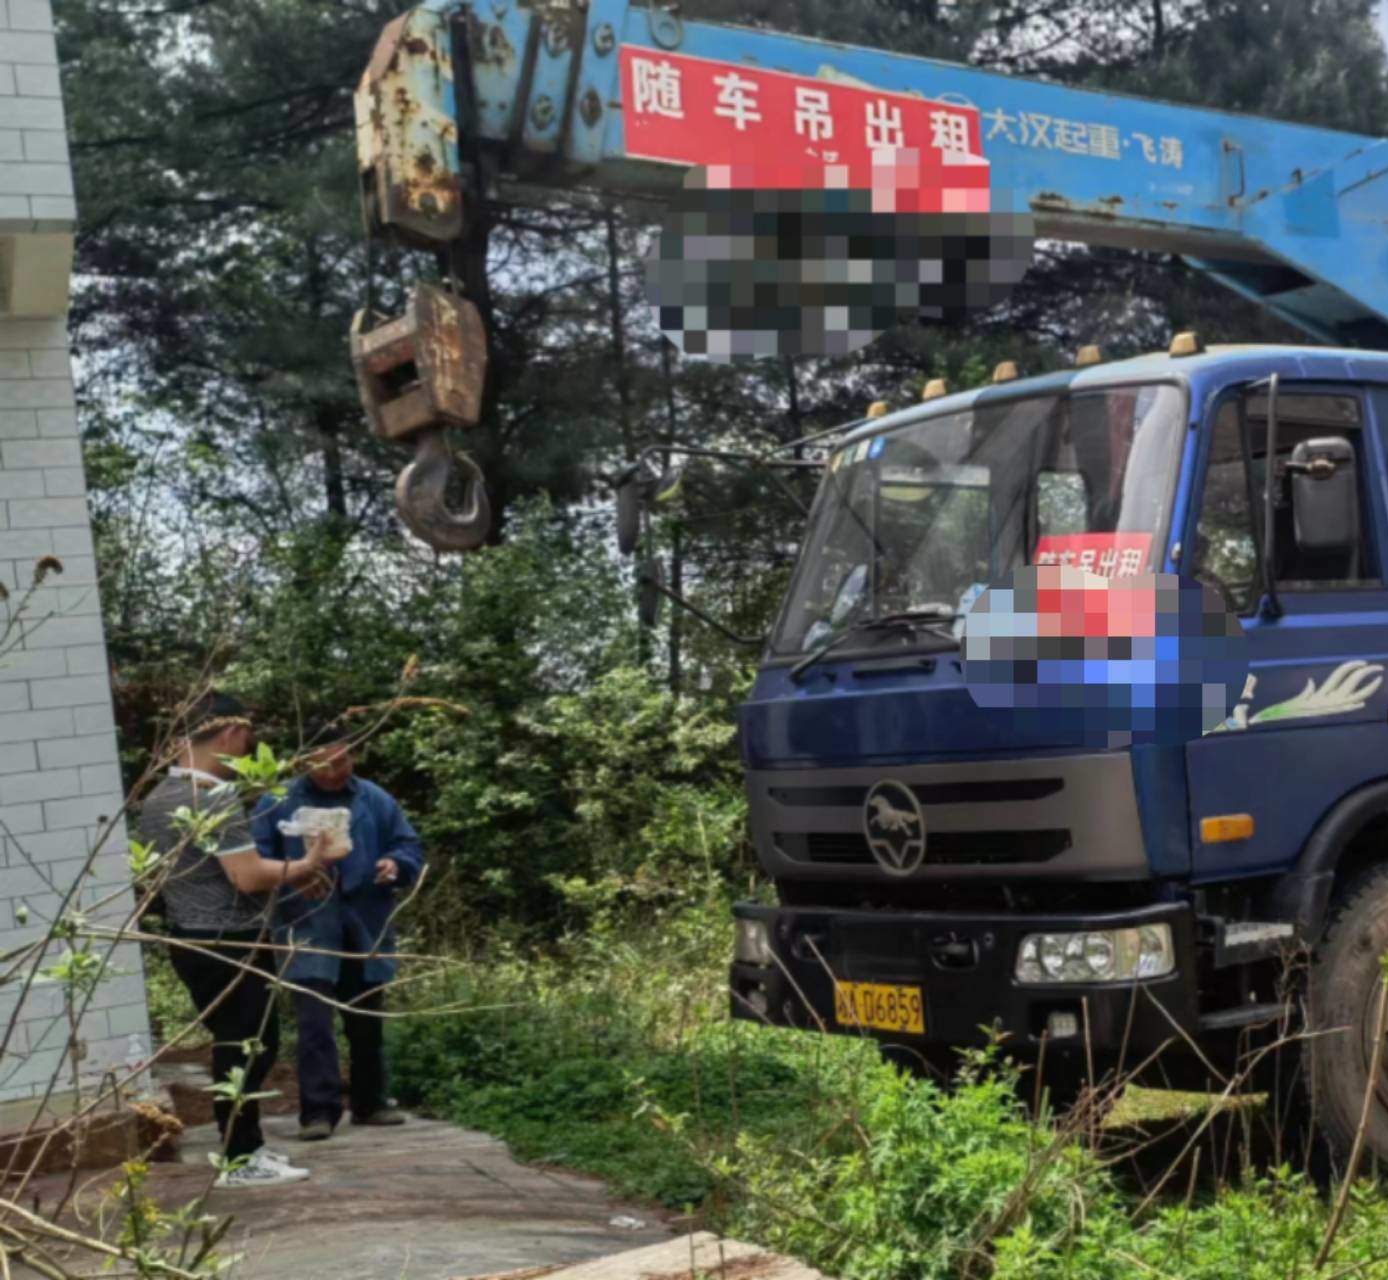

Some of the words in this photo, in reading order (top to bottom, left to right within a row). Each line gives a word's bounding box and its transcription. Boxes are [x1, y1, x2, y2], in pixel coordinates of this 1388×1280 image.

[631, 57, 970, 157] 随车吊出租
